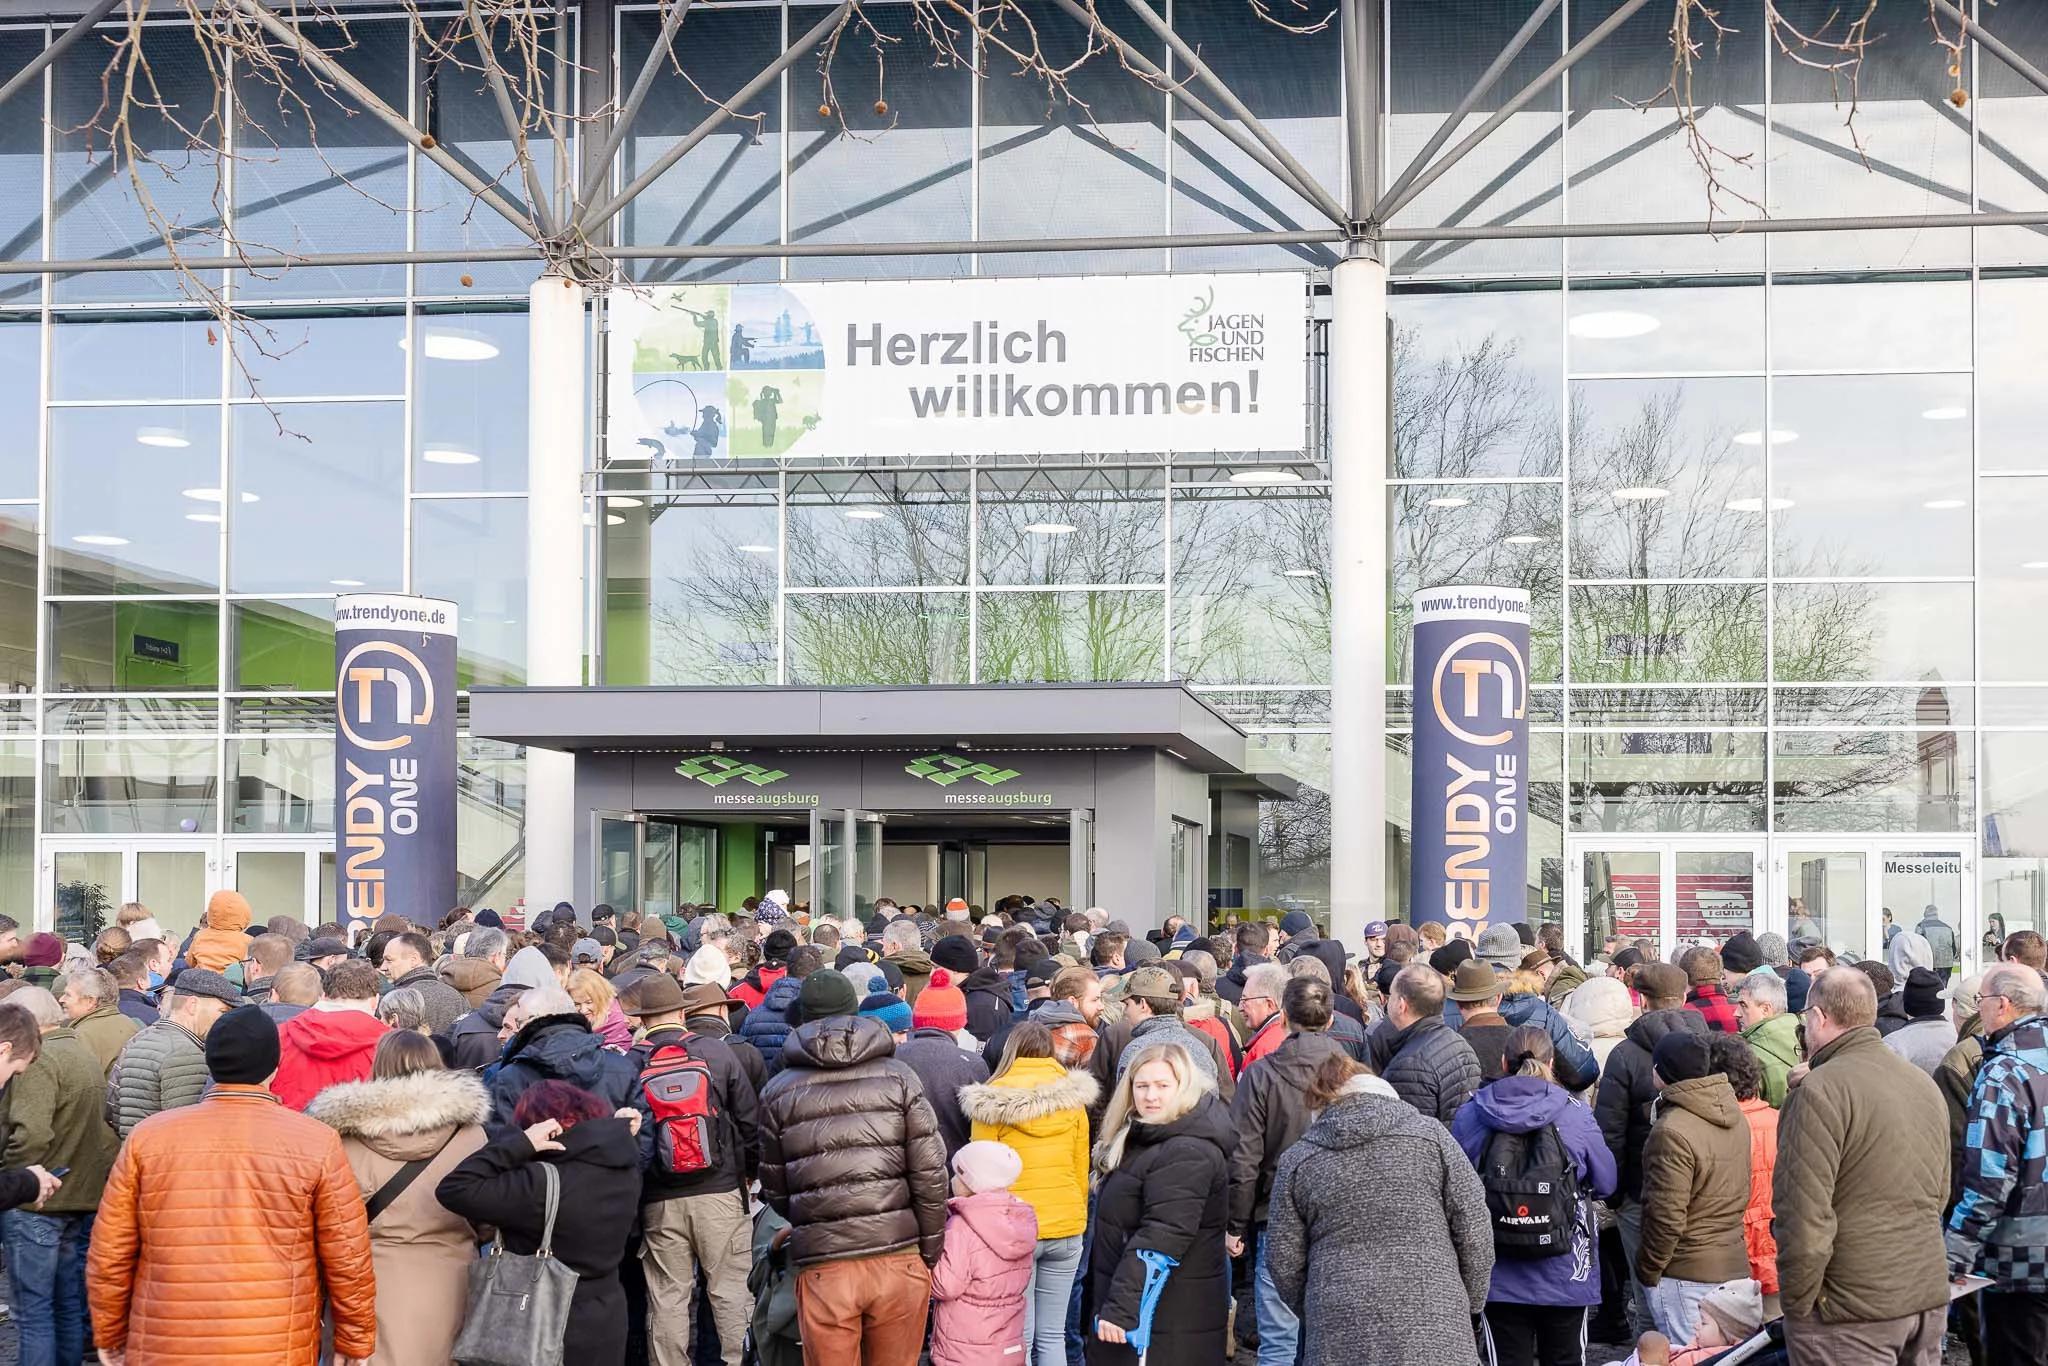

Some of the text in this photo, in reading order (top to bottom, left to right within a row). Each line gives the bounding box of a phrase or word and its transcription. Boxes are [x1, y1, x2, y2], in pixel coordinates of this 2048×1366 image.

[848, 320, 1066, 366] Herzlich
[1208, 313, 1264, 332] JAGEN
[1222, 331, 1264, 345] UND
[1190, 347, 1264, 362] FISCHEN
[908, 370, 1258, 418] willkommen!
[390, 758, 418, 835] ONE
[1495, 755, 1517, 834] ONE
[1445, 753, 1490, 949] RENDY
[1500, 1215, 1550, 1225] AIRWALK
